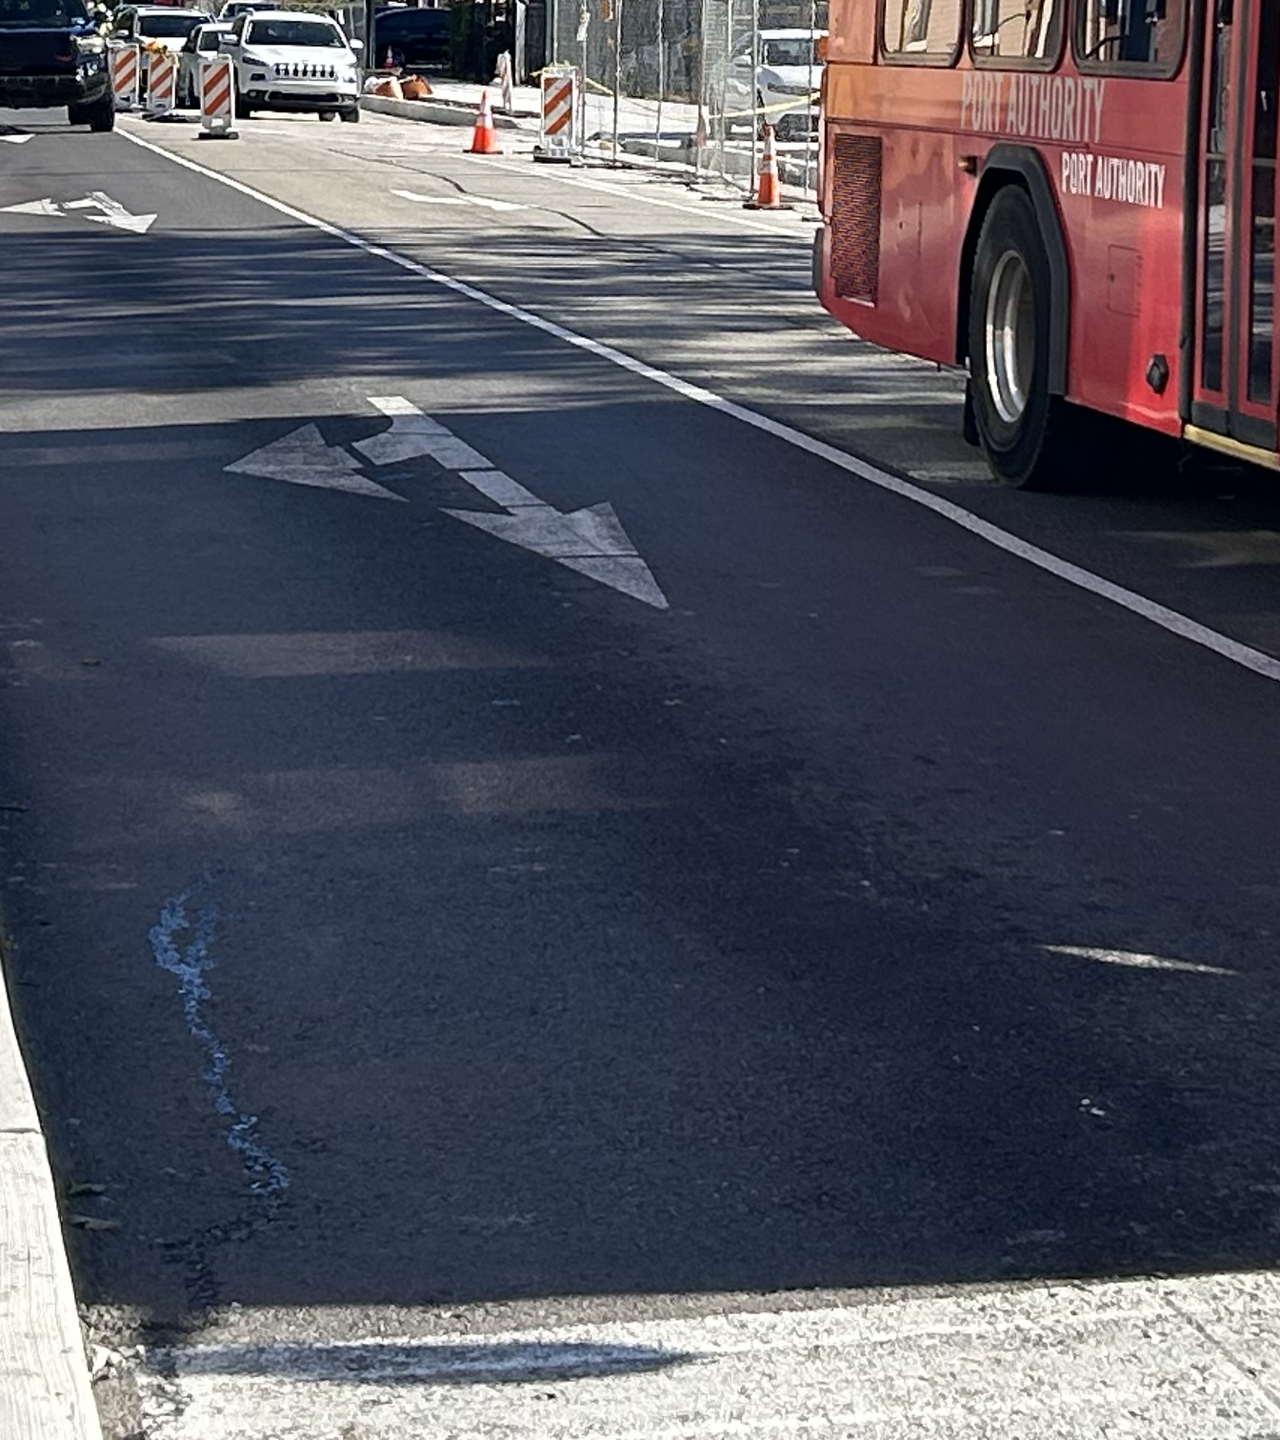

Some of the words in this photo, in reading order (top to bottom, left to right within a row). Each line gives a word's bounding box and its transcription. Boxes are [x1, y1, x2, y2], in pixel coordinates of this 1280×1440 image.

[960, 73, 1004, 132] PORT
[1005, 75, 1105, 144] AUTHORITY
[1061, 151, 1094, 196] PORT
[1094, 155, 1166, 209] AUTHORITY
